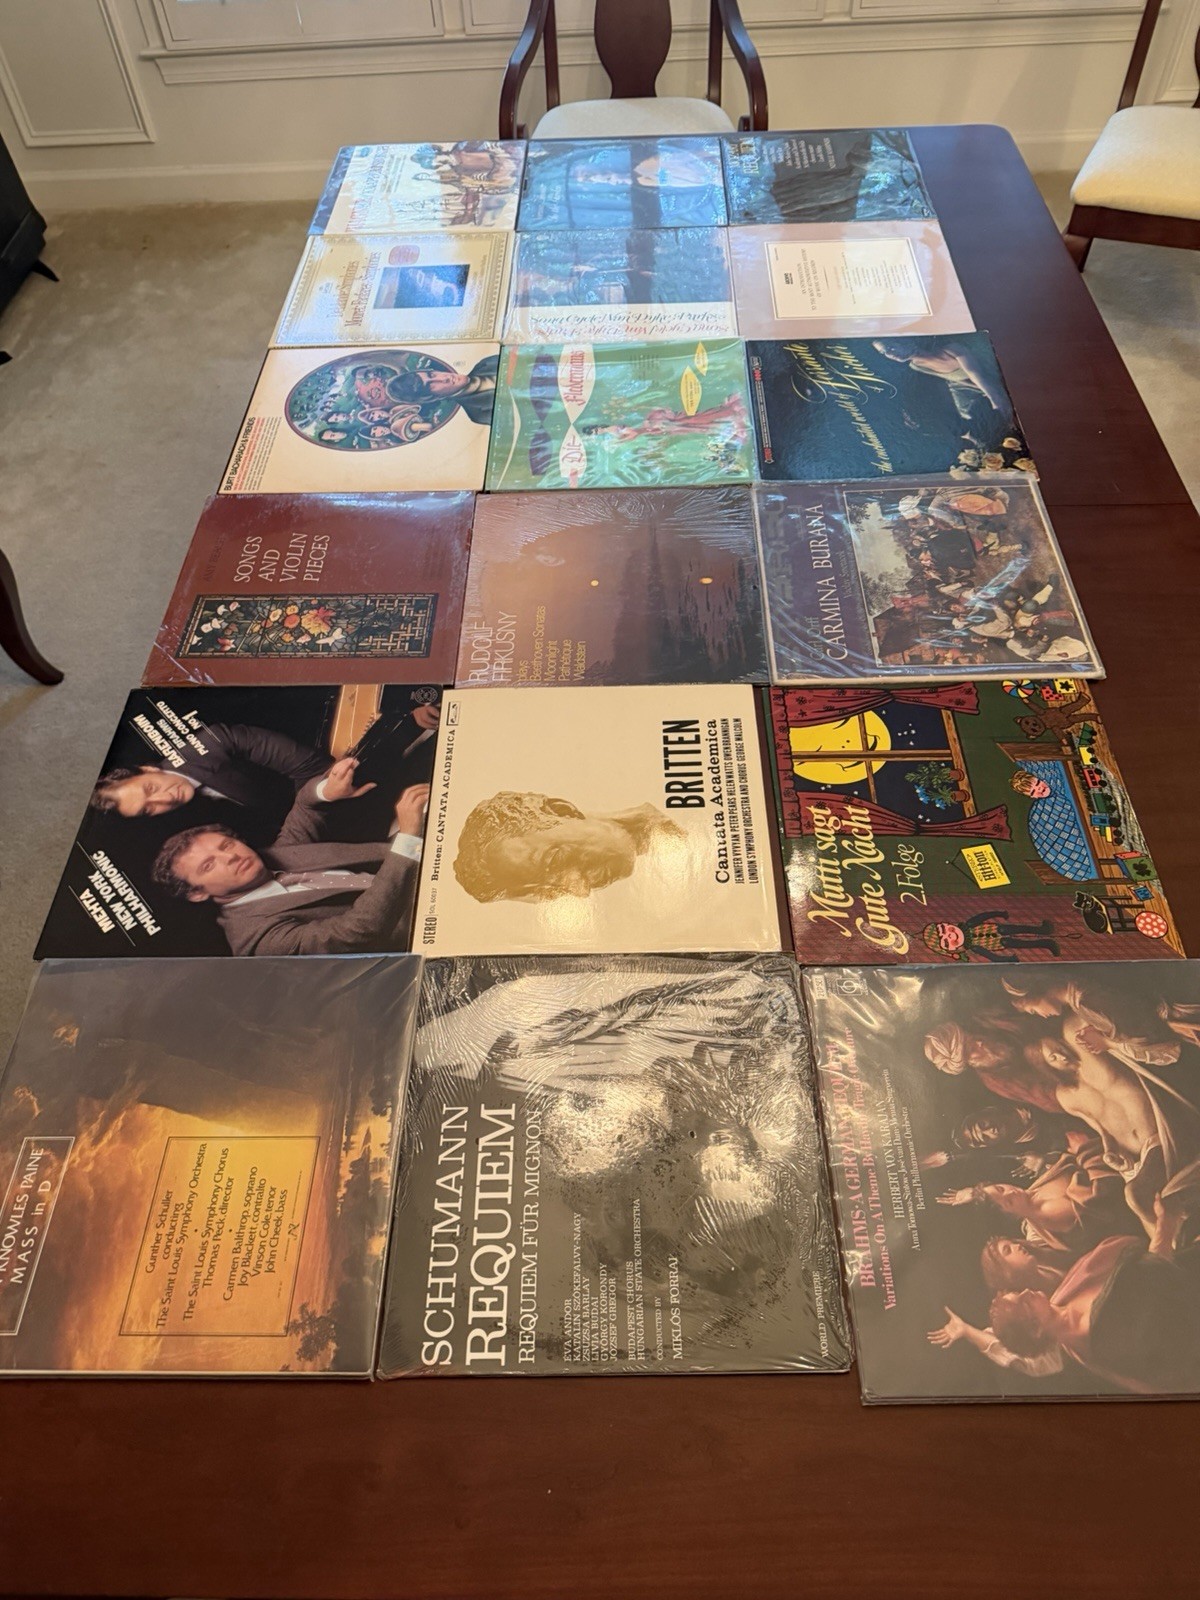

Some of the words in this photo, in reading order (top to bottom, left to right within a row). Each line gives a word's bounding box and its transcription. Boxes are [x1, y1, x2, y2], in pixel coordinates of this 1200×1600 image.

[223, 475, 236, 491] BURT
[230, 443, 246, 476] BACHARACH
[242, 416, 256, 438] FRIENDS
[562, 435, 583, 463] Die
[279, 533, 308, 583] VIOLIN
[804, 503, 833, 570] BURANA
[234, 536, 263, 583] SONGS
[258, 549, 281, 582] AND
[303, 535, 331, 582] PIECES
[533, 605, 546, 637] Sonatas
[804, 616, 823, 638] Orff
[817, 575, 849, 661] CARMINA
[468, 621, 493, 681] RUDOLF
[492, 611, 518, 681] FIRKUSNY
[529, 638, 544, 681] Beethoven
[544, 640, 560, 681] Moonlight
[573, 641, 587, 681] Waldstein
[810, 640, 825, 662] Carl
[517, 660, 528, 681] plays
[156, 701, 189, 734] CONCERTO
[156, 718, 187, 749] BRAHMS
[133, 714, 185, 768] BARENBOIM
[186, 734, 209, 756] PIANO
[442, 729, 456, 790] ACADEMICA
[722, 746, 733, 761] OWEN
[735, 742, 745, 762] GEORGE
[662, 719, 706, 809] BRITTEN
[705, 719, 724, 807] Academica
[724, 762, 735, 779] WATTS
[737, 762, 747, 784] CHORUS
[725, 780, 736, 796] HELEN
[726, 797, 738, 815] PEARS
[739, 784, 749, 796] AND
[436, 792, 450, 843] CANTATA
[728, 815, 739, 833] PETER
[740, 796, 753, 827] ORCHESTRA
[806, 805, 841, 853] sagt
[431, 844, 443, 882] Britten:
[714, 810, 730, 884] Cantata
[744, 827, 756, 859] SYMPHONY
[841, 805, 885, 881] Nacht
[88, 870, 117, 903] YORK
[732, 856, 745, 884] JENNIFER
[747, 860, 759, 884] LONDON
[79, 888, 116, 934] MEHTA
[92, 850, 162, 936] PHILHARMONIC
[807, 856, 854, 938] Mutti
[109, 901, 138, 931] NEW
[423, 916, 438, 945] STEREO
[855, 882, 910, 955] Gute
[876, 1100, 892, 1147] KARAJAN
[20, 1148, 44, 1189] PAINE
[189, 1143, 208, 1189] Orchestra
[213, 1147, 230, 1184] Chorus
[523, 1108, 543, 1198] MIGNON
[862, 1153, 877, 1167] By
[884, 1148, 896, 1168] VON
[38, 1180, 52, 1193] D
[868, 1168, 882, 1210] Theme
[887, 1170, 905, 1219] HERBERT
[915, 1188, 926, 1210] Berlin
[31, 1201, 46, 1216] in
[174, 1189, 199, 1244] Symphony
[201, 1183, 224, 1238] Symphony
[519, 1201, 540, 1248] FÜR
[633, 1198, 642, 1258] ORCHESTRA
[871, 1212, 884, 1221] A
[145, 1231, 163, 1274] Gunther
[156, 1189, 174, 1230] Schuller
[162, 1201, 185, 1260] conducting
[202, 1243, 220, 1289] Thomas
[221, 1176, 235, 1214] director
[223, 1258, 240, 1301] Carmen
[243, 1166, 259, 1208] soprano
[237, 1266, 252, 1288] Joy
[251, 1178, 267, 1223] contralto
[250, 1240, 267, 1278] Vinson
[265, 1185, 278, 1214] tenor
[264, 1250, 278, 1275] John
[275, 1189, 288, 1213] bass
[421, 1103, 470, 1366] SCHUMANN
[465, 1103, 517, 1366] REQUIEM
[850, 1208, 876, 1287] BRAHMS
[874, 1224, 887, 1244] On
[911, 1230, 921, 1250] Anna
[10, 1225, 38, 1284] MASS
[168, 1244, 184, 1275] Louis
[194, 1237, 209, 1268] Louis
[162, 1276, 176, 1306] Saint
[188, 1268, 203, 1298] Saint
[582, 1276, 590, 1319] BARLAY
[600, 1262, 608, 1316] KORONDY
[626, 1260, 634, 1304] CHORUS
[634, 1258, 643, 1296] STATE
[812, 1270, 825, 1319] PREMIERE
[879, 1245, 897, 1311] Variations
[156, 1307, 170, 1329] The
[183, 1300, 196, 1322] The
[518, 1251, 539, 1364] REQUIEM
[564, 1299, 572, 1335] ANDOR
[591, 1296, 599, 1331] BUDAI
[608, 1277, 617, 1322] GREGOR
[654, 1296, 662, 1307] BY
[573, 1313, 581, 1362] KATALIN
[582, 1321, 591, 1362] ZSUZSA
[627, 1304, 636, 1361] BUDAPEST
[635, 1297, 645, 1361] HUNGARIAN
[655, 1308, 664, 1361] CONDUCTED
[818, 1322, 829, 1358] WORLD
